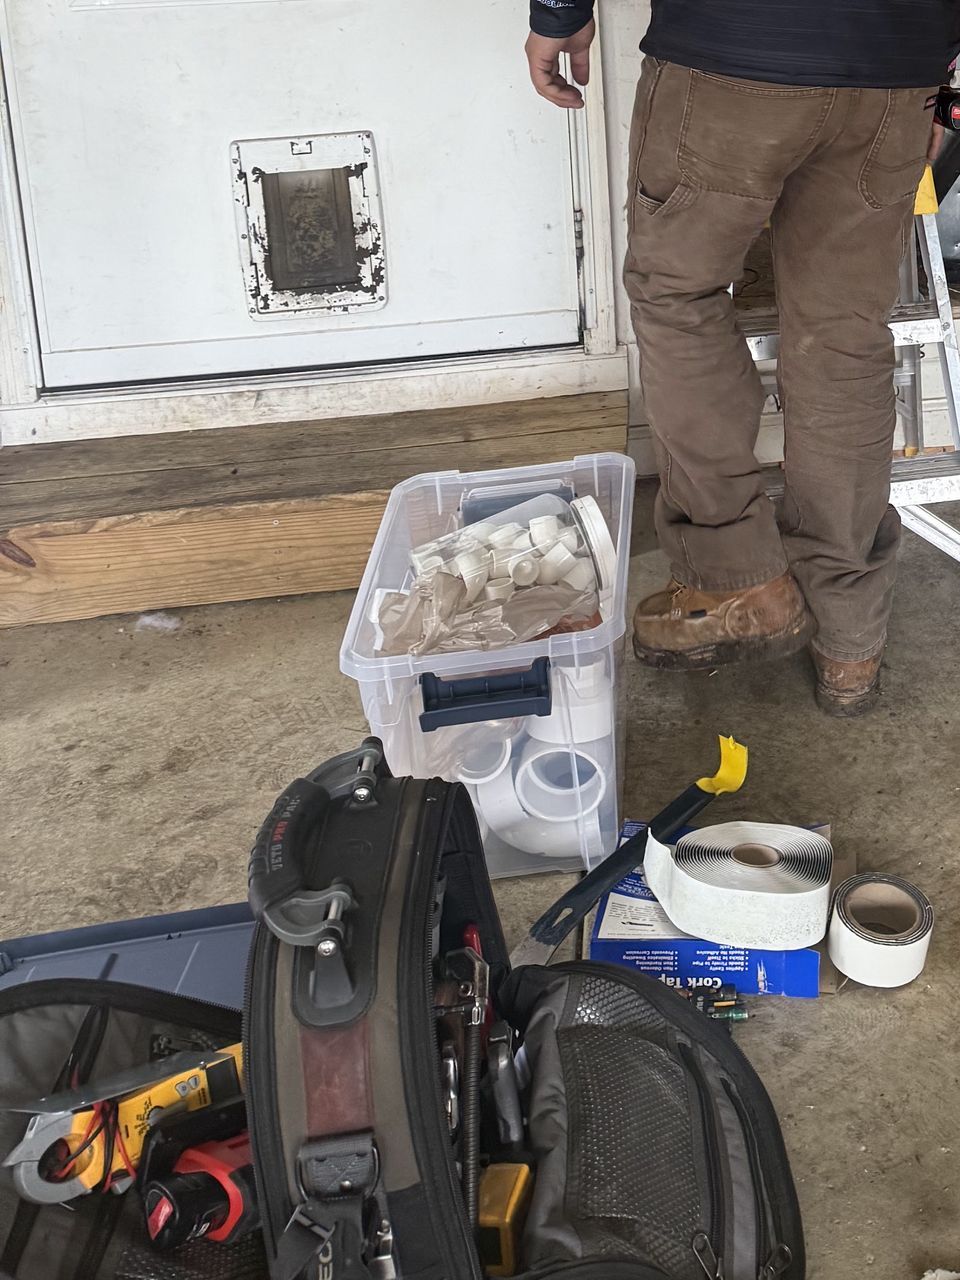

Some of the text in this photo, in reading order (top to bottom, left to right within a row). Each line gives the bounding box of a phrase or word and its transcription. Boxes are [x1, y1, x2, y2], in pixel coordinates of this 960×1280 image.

[270, 843, 283, 871] VETO
[658, 974, 722, 990] Cork Tap
